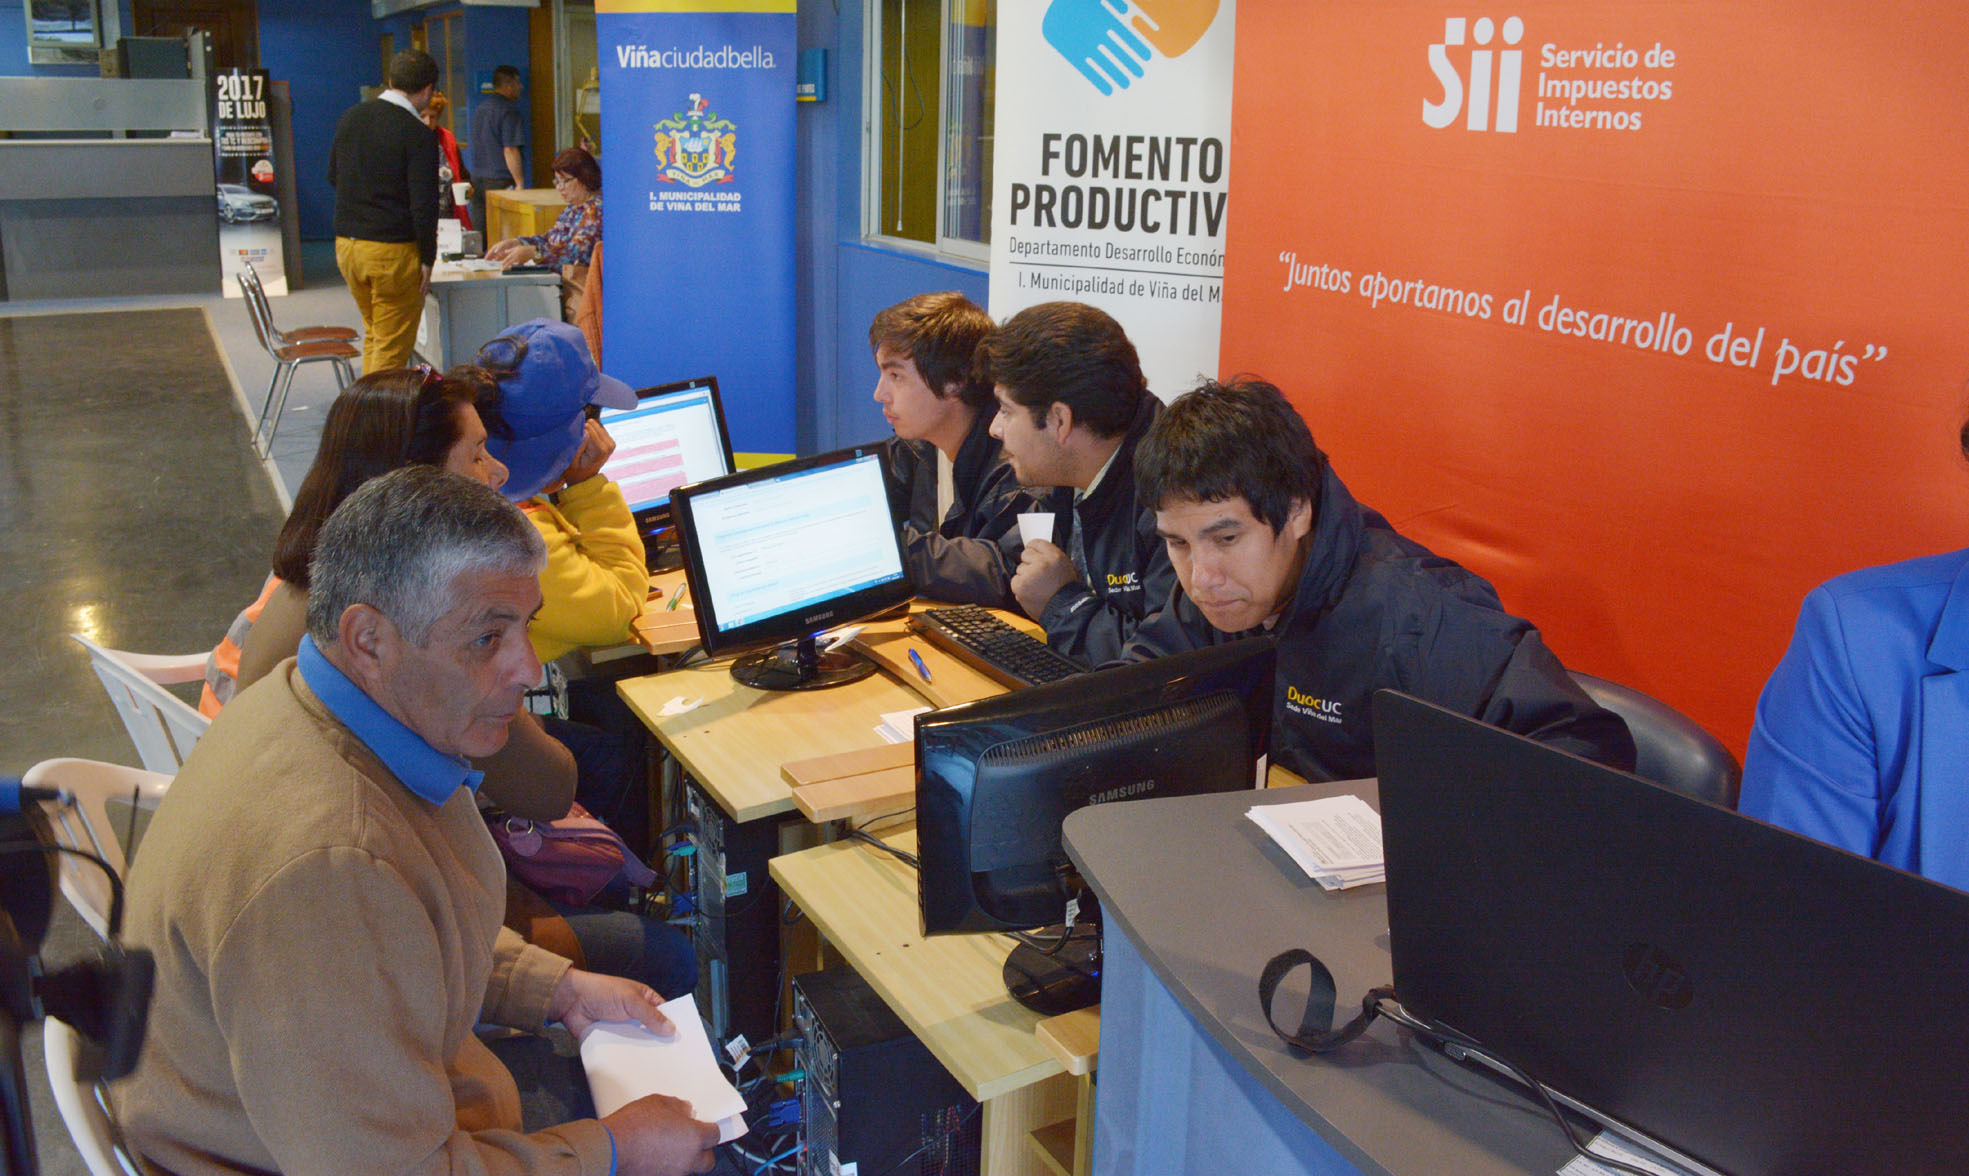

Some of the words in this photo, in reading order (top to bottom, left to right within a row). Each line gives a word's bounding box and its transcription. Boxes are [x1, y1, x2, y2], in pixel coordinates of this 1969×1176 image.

[1540, 42, 1638, 68] Servicio
[1644, 42, 1676, 68] de
[217, 74, 264, 101] 2017
[1538, 72, 1673, 106] Impuestos
[218, 101, 234, 119] DE
[236, 101, 266, 119] LUJO
[1535, 101, 1642, 130] Internos
[1041, 133, 1223, 184] FOMENTO
[649, 192, 657, 201] I.
[659, 192, 742, 202] MUNICIPALIDAD
[649, 202, 664, 210] DE
[694, 202, 715, 212] DEL
[717, 203, 741, 212] MAR
[1010, 183, 1227, 237] PRODUCTIV
[1009, 236, 1101, 258] Departamento
[1105, 242, 1172, 264] Desarrollo
[1030, 272, 1124, 296] Municipalidad
[1129, 278, 1145, 296] de
[1149, 281, 1177, 300] Viña
[1182, 283, 1204, 302] del
[1208, 285, 1223, 303] M
[1359, 271, 1493, 320] aportamos
[1502, 289, 1531, 326] al
[1538, 294, 1693, 356] desarrollo
[1705, 322, 1766, 368] del
[805, 610, 834, 625] SAMSUNG
[1089, 779, 1155, 806] SAMSUNG
